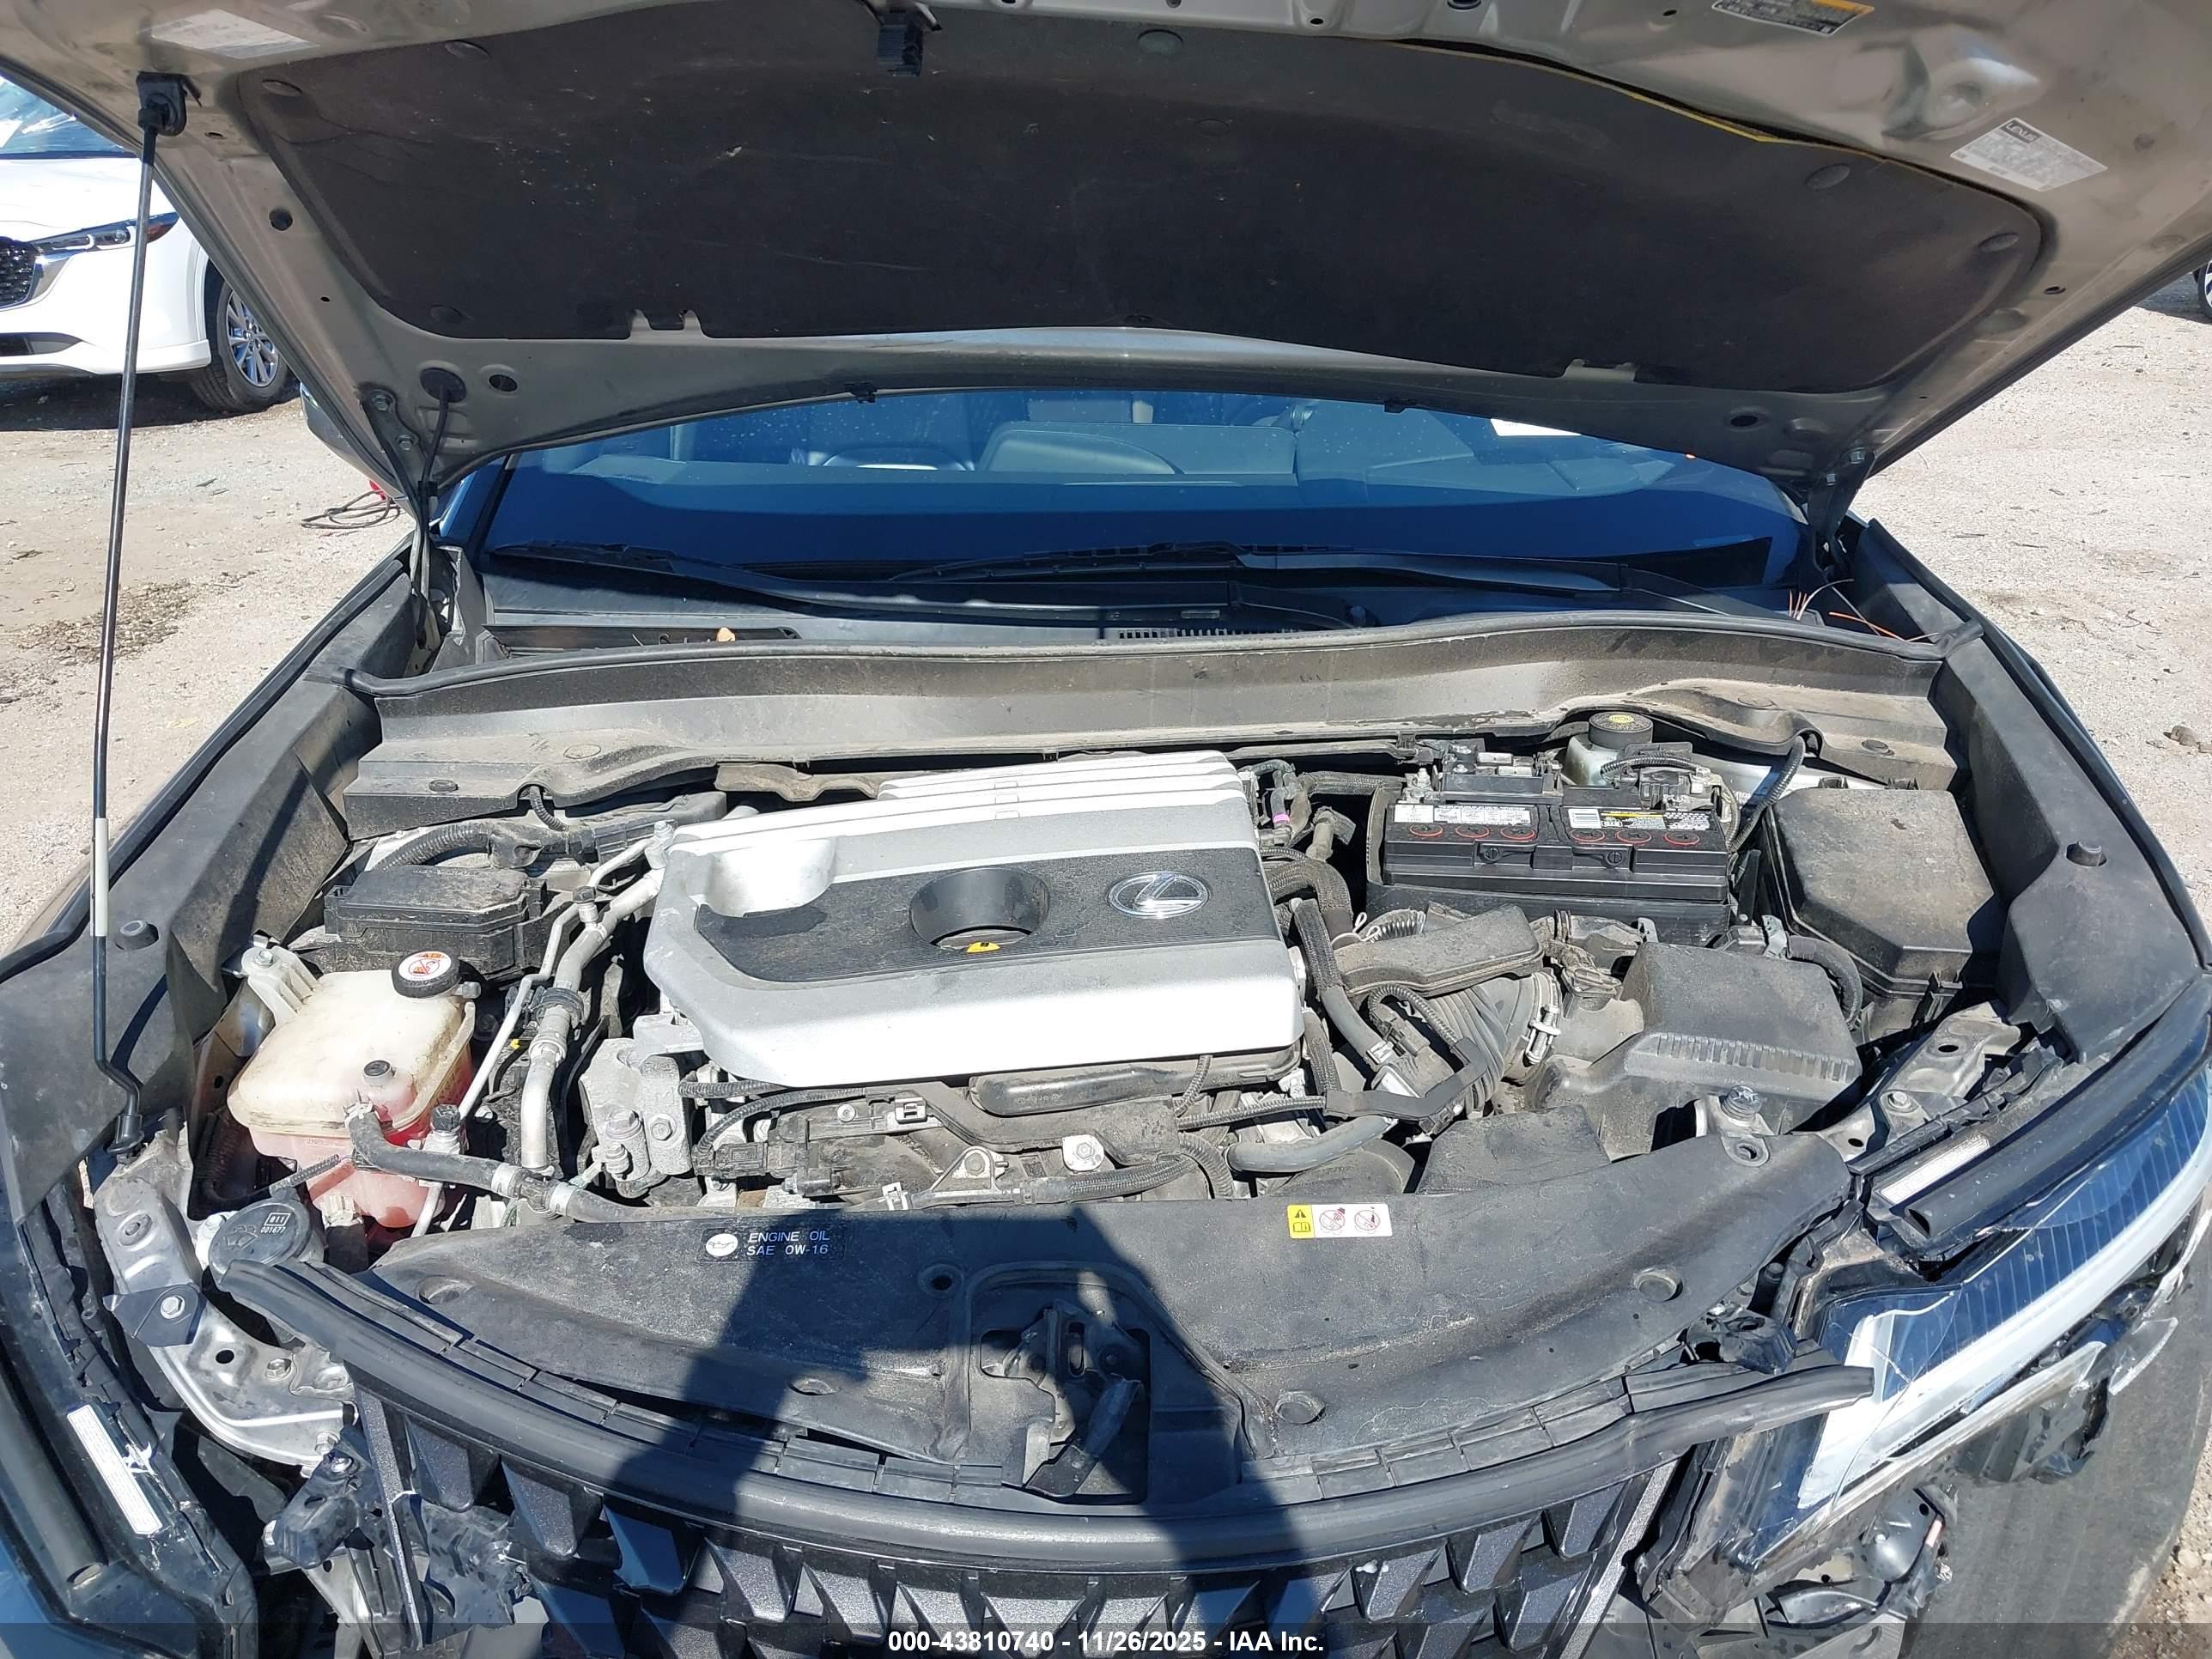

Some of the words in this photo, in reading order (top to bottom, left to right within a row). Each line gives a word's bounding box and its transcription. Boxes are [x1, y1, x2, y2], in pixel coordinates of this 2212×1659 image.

[2006, 123, 2037, 141] LEXUS
[748, 1231, 799, 1243] ENGINE
[809, 1231, 830, 1241] OIL
[746, 1245, 775, 1255] SAE
[785, 1244, 828, 1255] 0W-16
